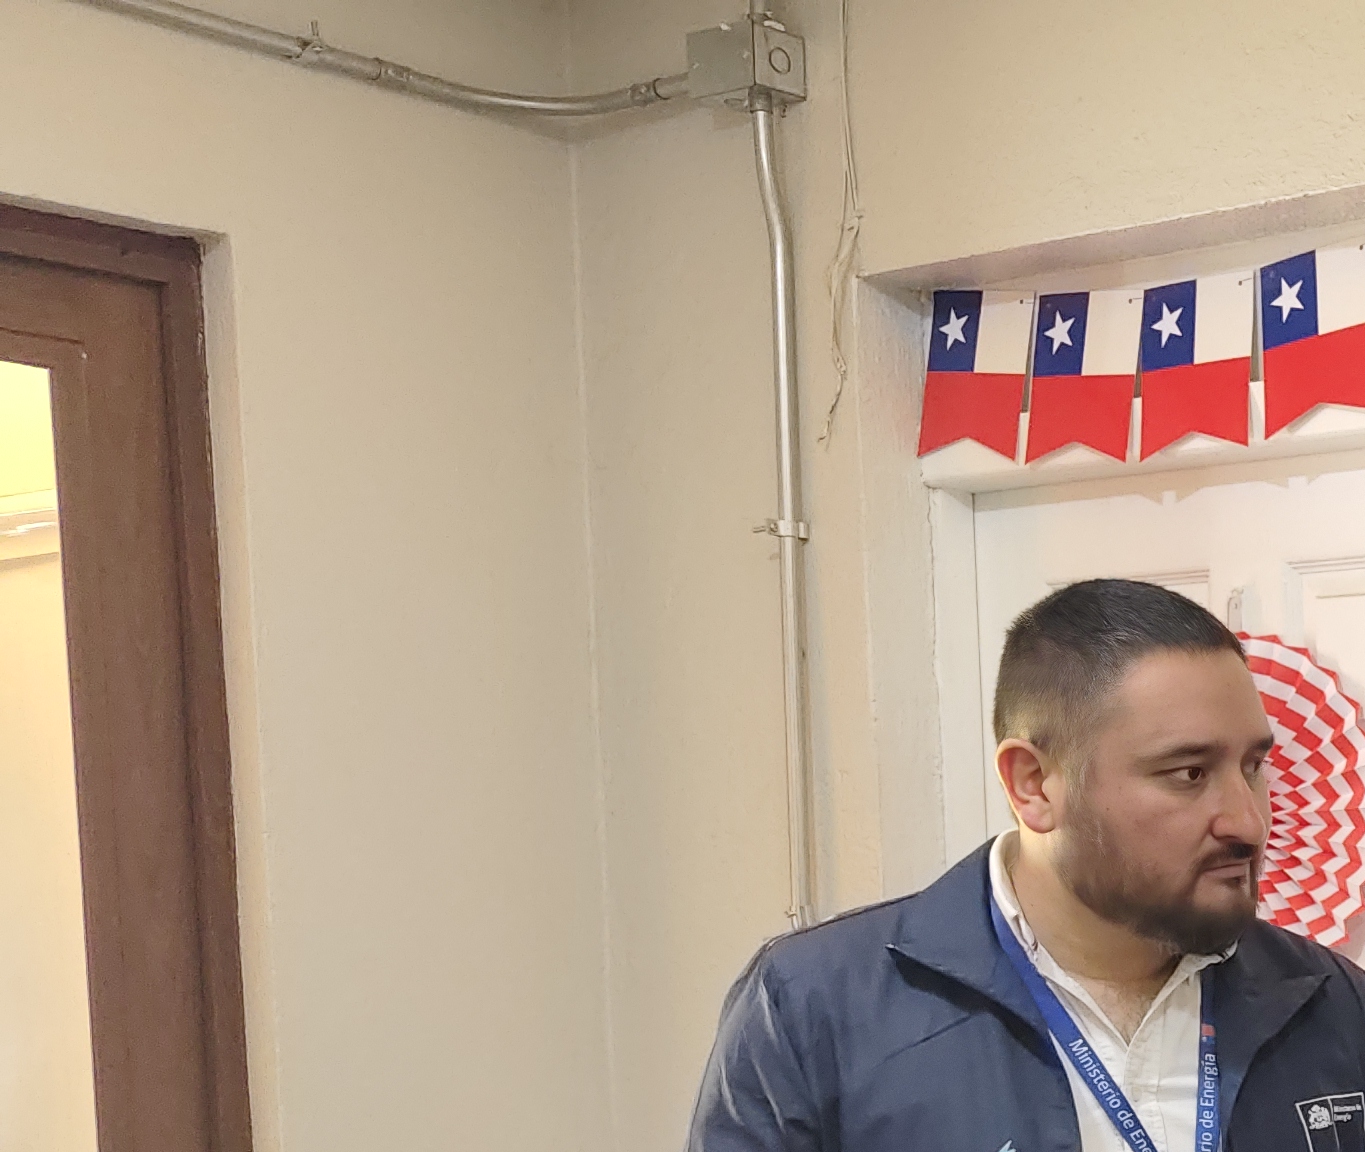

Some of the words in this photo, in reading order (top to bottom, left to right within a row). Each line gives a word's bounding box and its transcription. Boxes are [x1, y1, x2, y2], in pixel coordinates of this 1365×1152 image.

[1069, 1038, 1121, 1109] Ministerio
[1117, 1109, 1135, 1129] de
[1200, 1053, 1219, 1107] Energía
[1199, 1110, 1214, 1129] de
